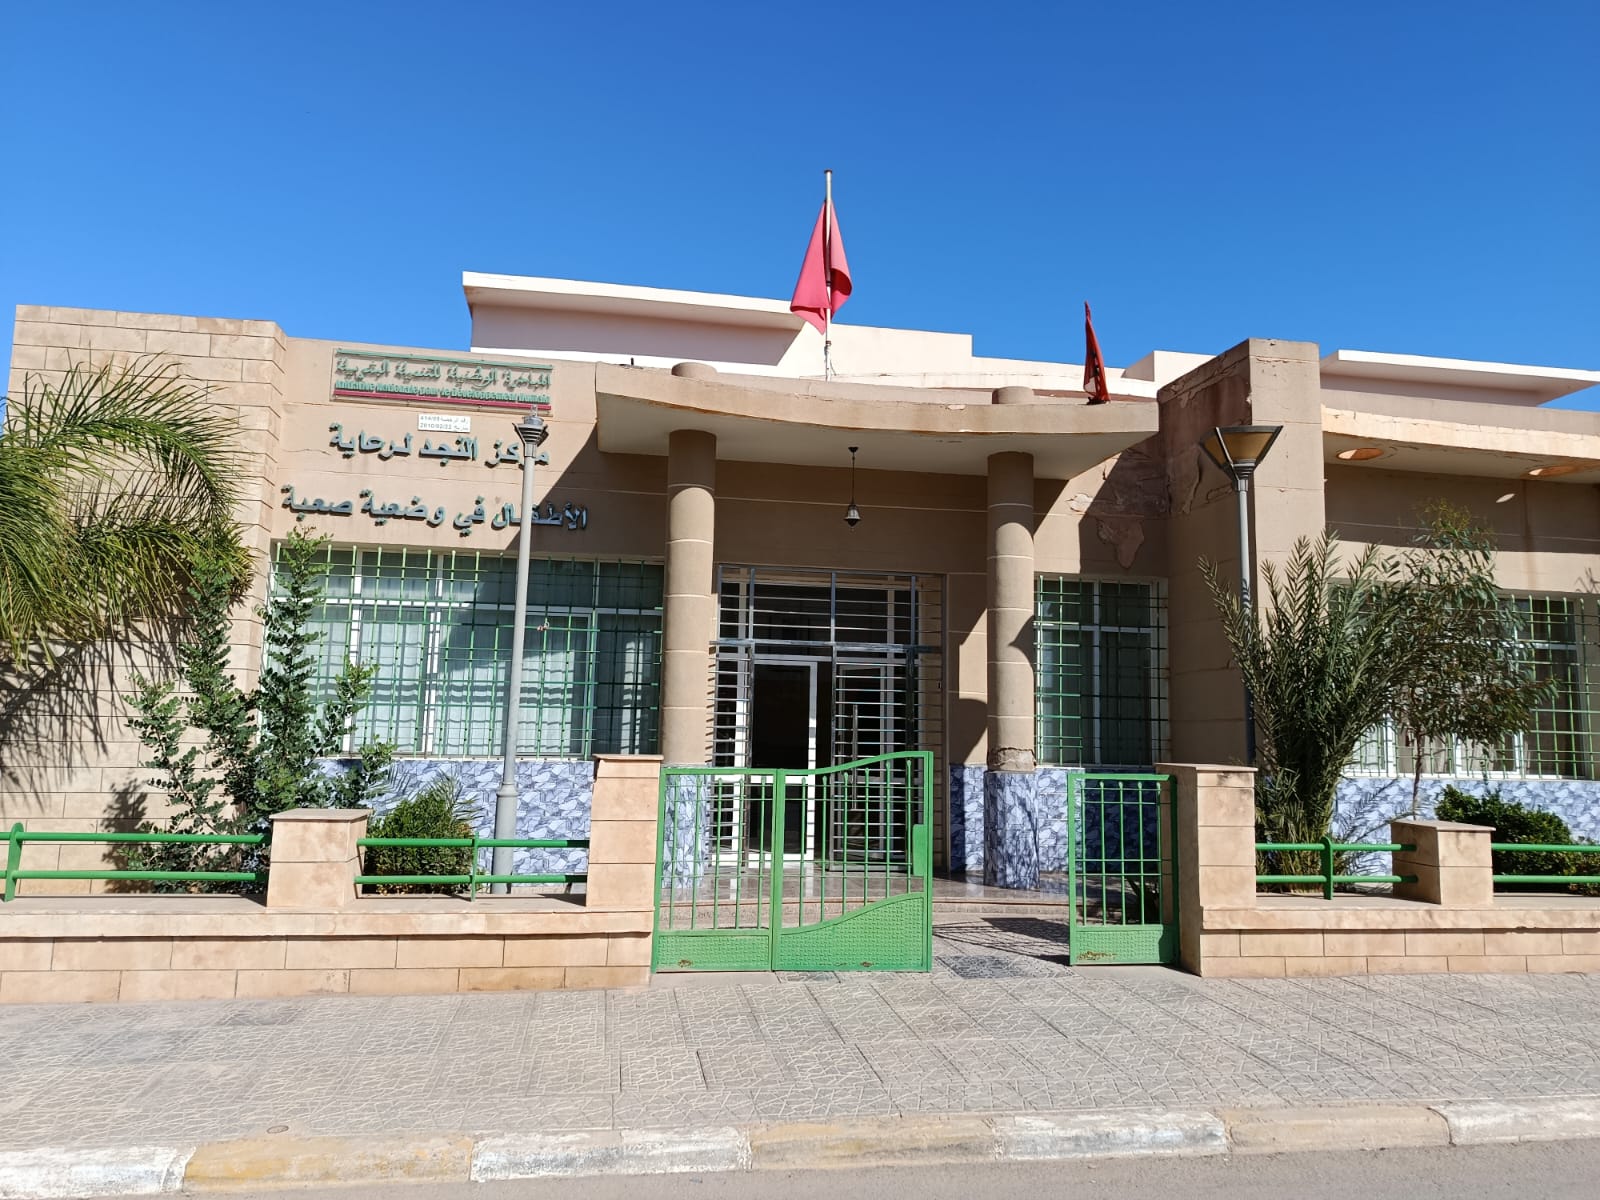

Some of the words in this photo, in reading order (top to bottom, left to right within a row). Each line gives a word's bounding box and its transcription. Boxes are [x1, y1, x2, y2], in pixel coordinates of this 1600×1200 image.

[336, 356, 390, 381] البشرية
[394, 361, 441, 382] للتنمية
[447, 364, 498, 390] الوطنية
[329, 421, 412, 461] لرعاية
[281, 484, 353, 522] صعبة
[454, 495, 485, 538] في
